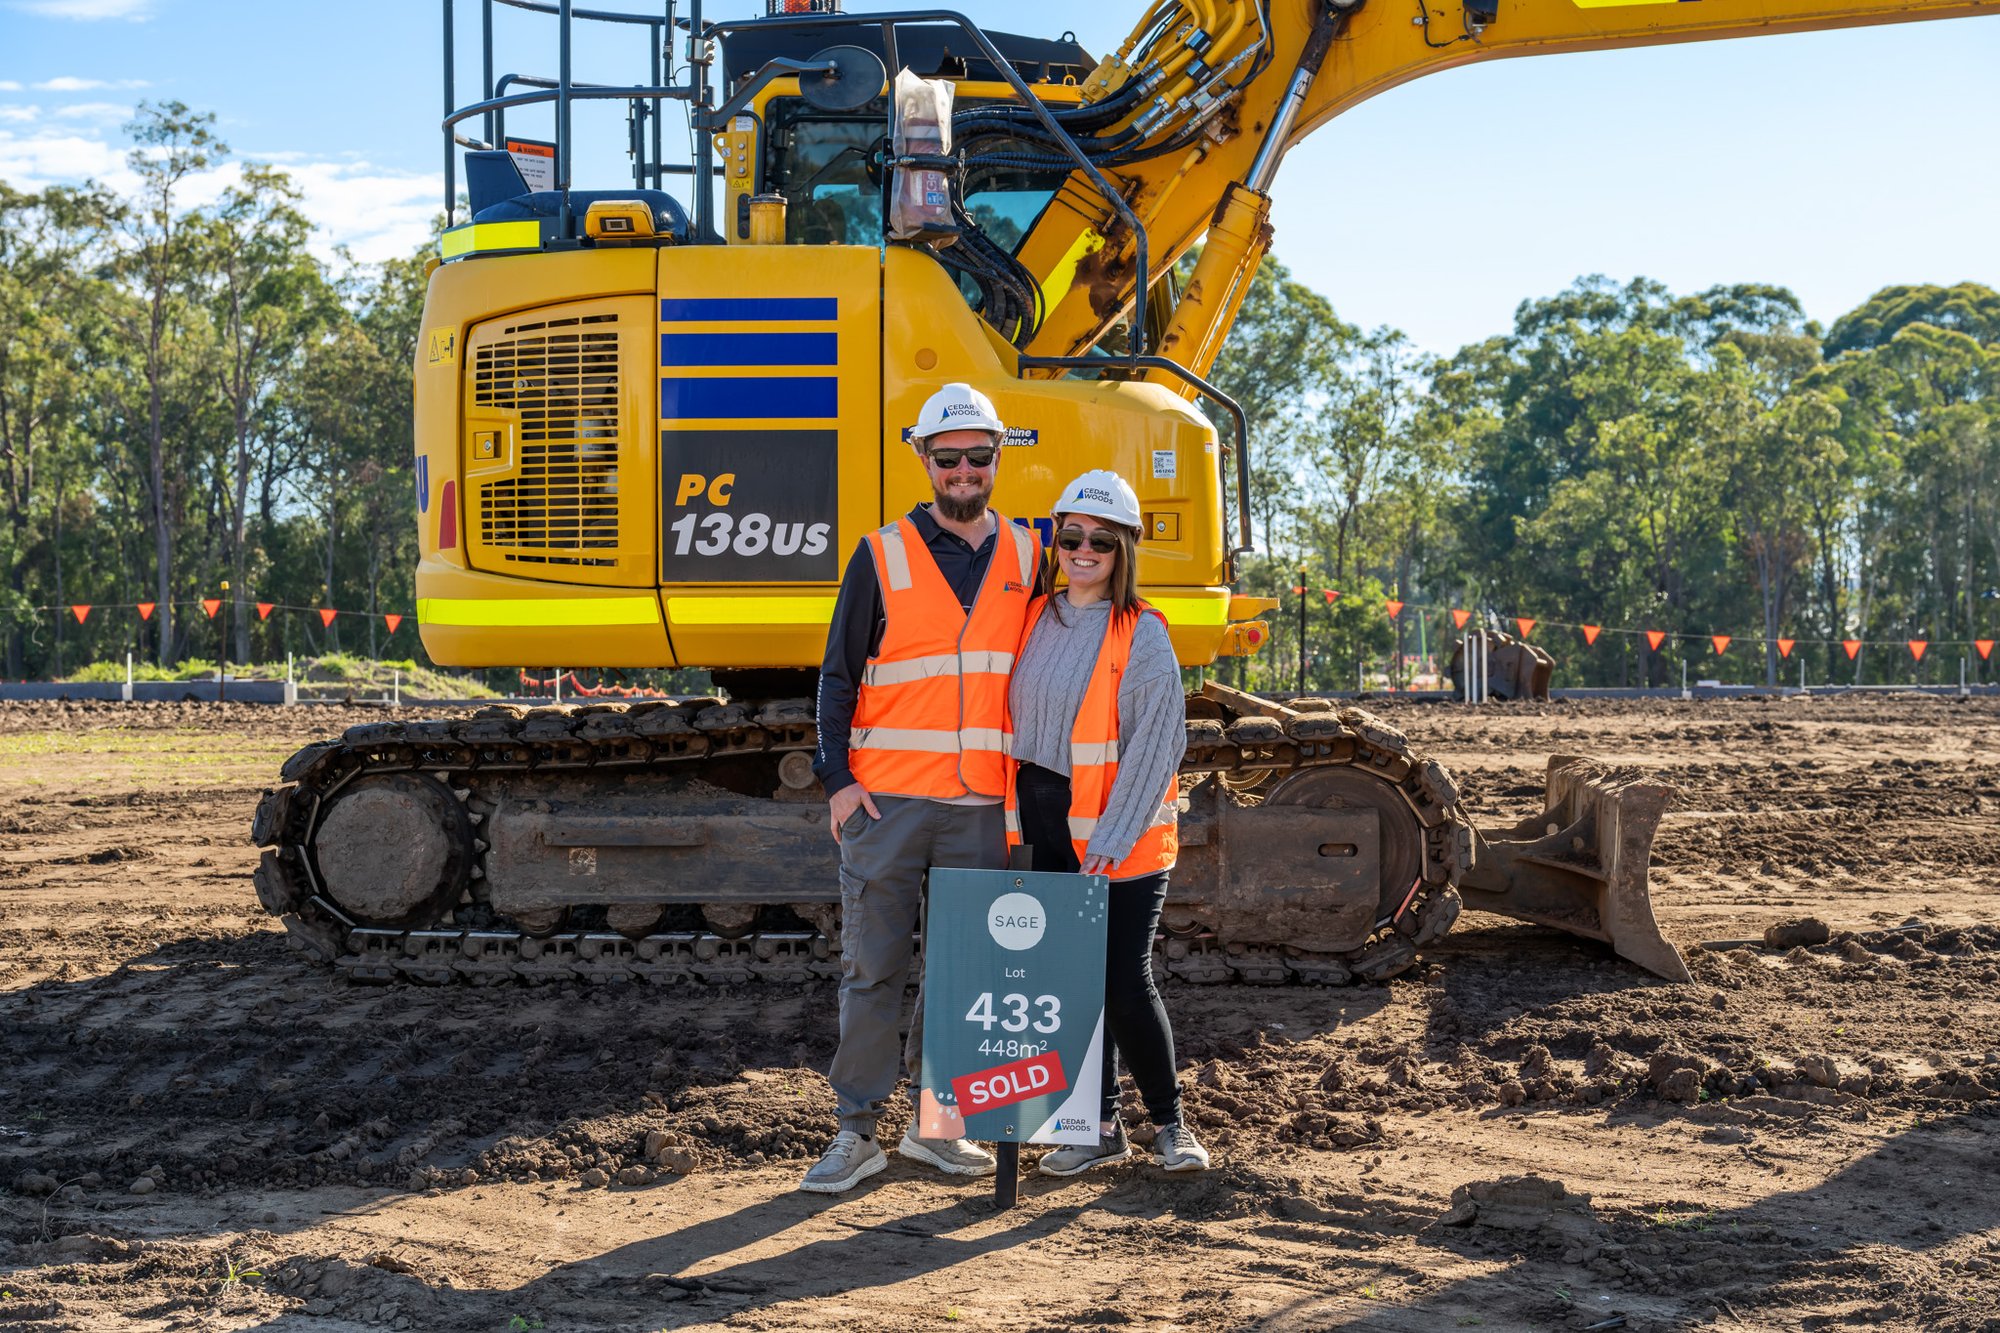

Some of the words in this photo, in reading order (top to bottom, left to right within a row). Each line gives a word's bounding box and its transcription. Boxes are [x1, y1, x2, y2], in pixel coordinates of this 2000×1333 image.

[949, 409, 981, 417] WOODS
[675, 473, 736, 506] PC
[1084, 487, 1110, 498] CEDAR
[1084, 493, 1114, 505] WOODS
[994, 915, 1040, 929] SAGE
[1005, 967, 1026, 979] Lot
[965, 992, 1062, 1034] 433
[969, 1064, 1050, 1104] SOLD
[1061, 1118, 1086, 1126] CEDAR
